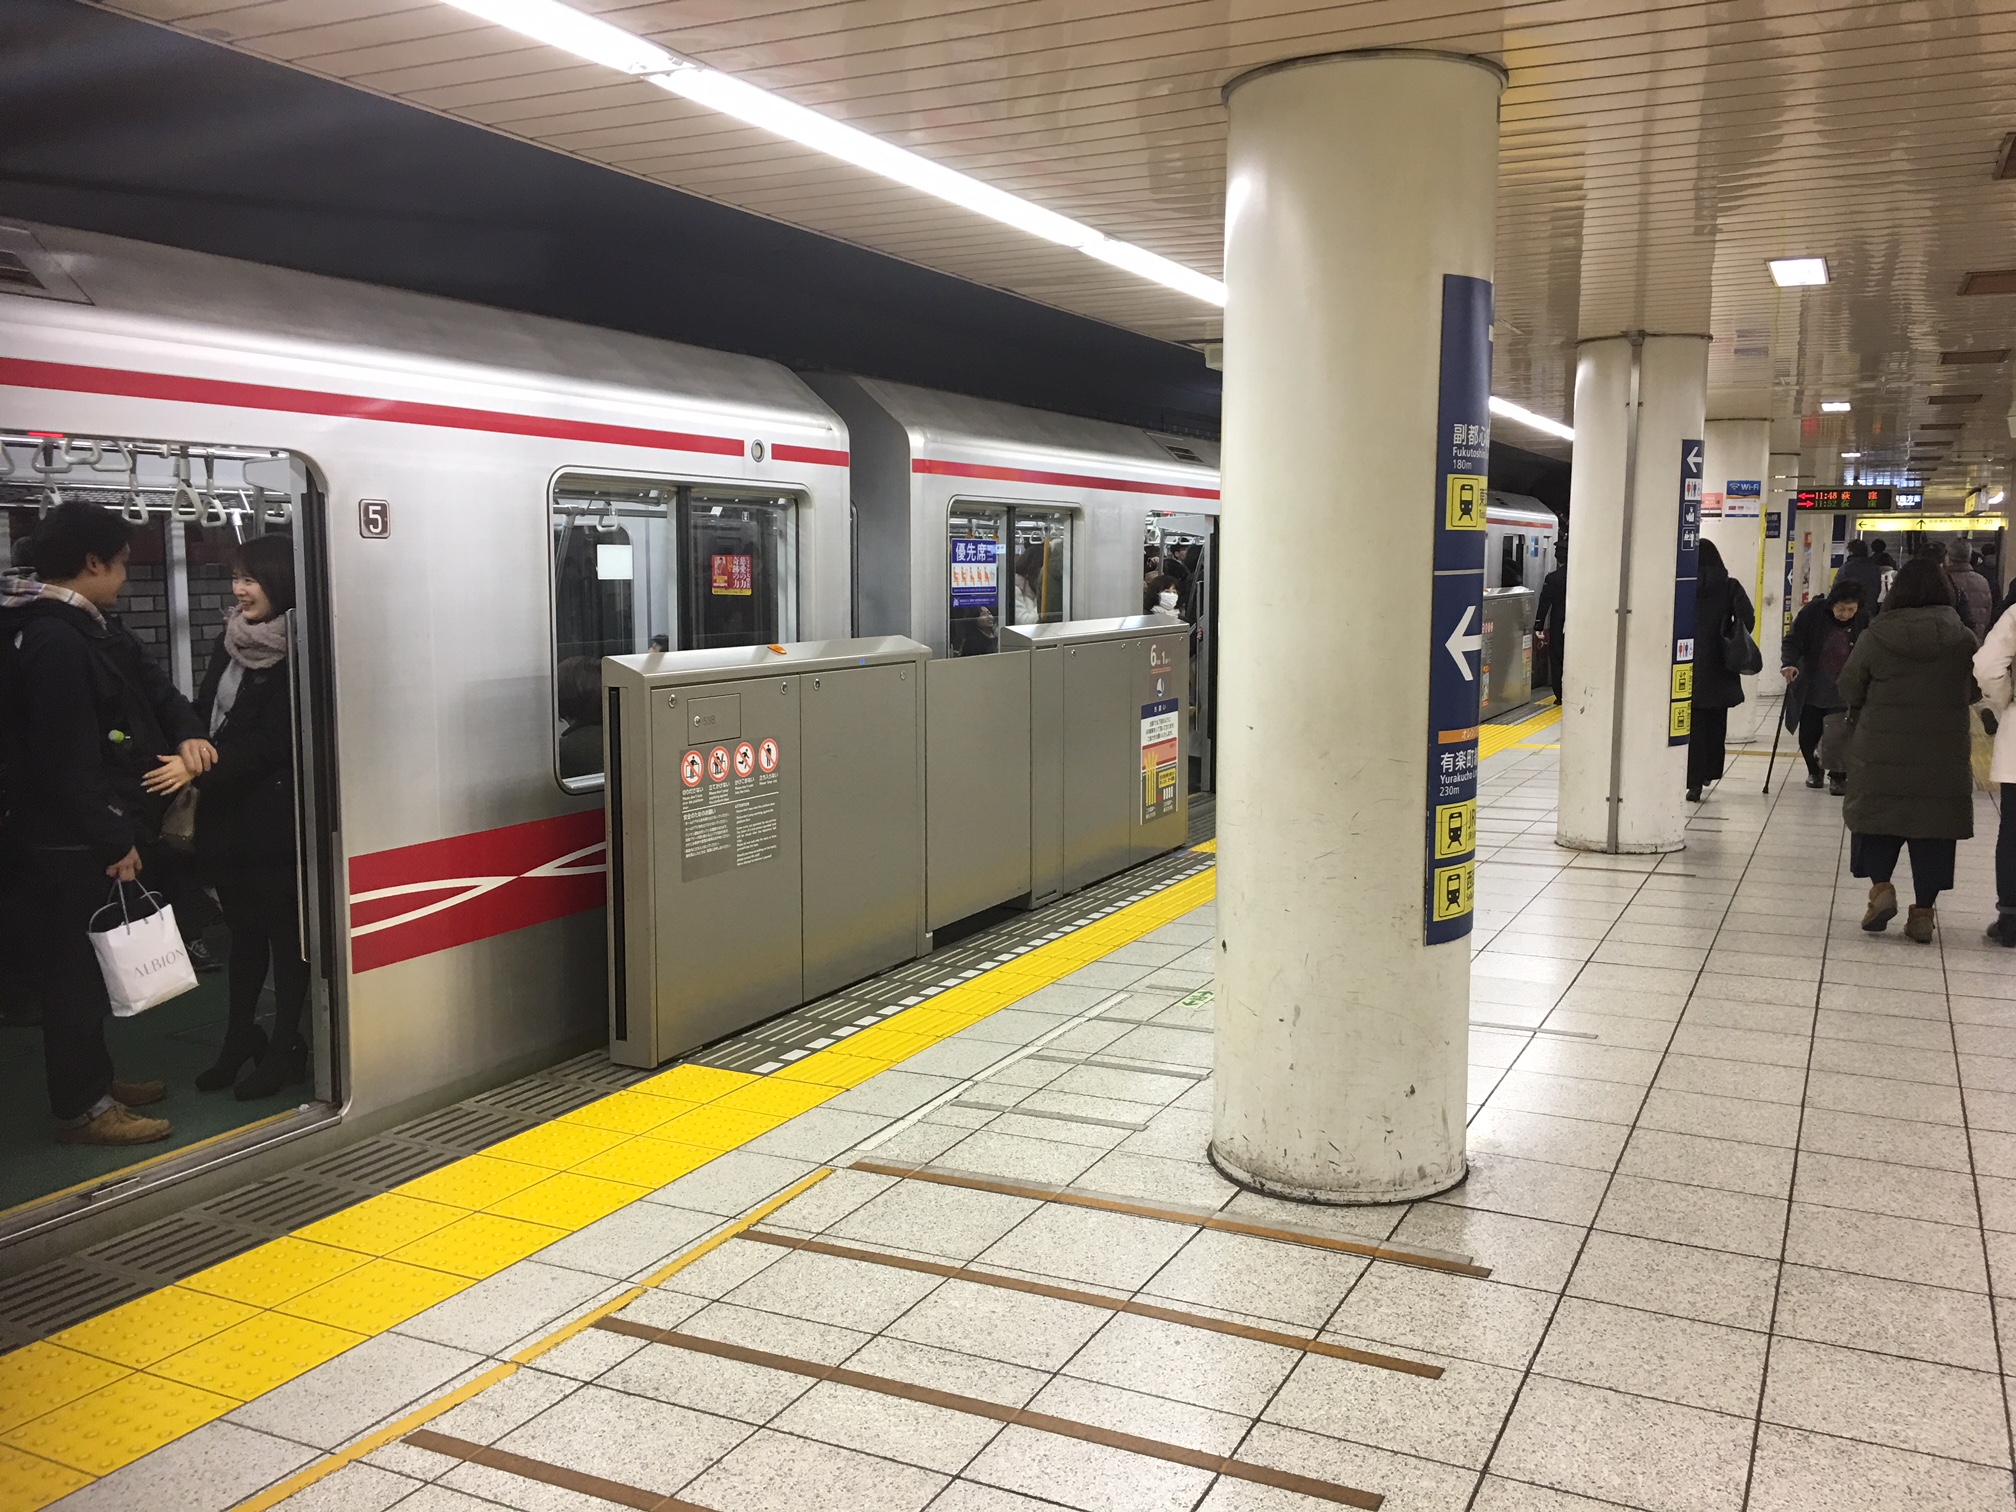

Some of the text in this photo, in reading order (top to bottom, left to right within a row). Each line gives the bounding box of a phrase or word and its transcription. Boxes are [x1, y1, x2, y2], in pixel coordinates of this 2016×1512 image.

[1453, 423, 1490, 447] 副都心
[1452, 459, 1473, 470] 180m
[1741, 483, 1759, 491] Wi-Fi
[1815, 491, 1838, 500] 11:48
[369, 506, 382, 533] 5
[955, 542, 986, 562] 優先席
[1150, 644, 1157, 666] 6
[1440, 770, 1472, 785] Yurakucho
[1439, 786, 1460, 797] 230m
[134, 949, 184, 977] ALBION
